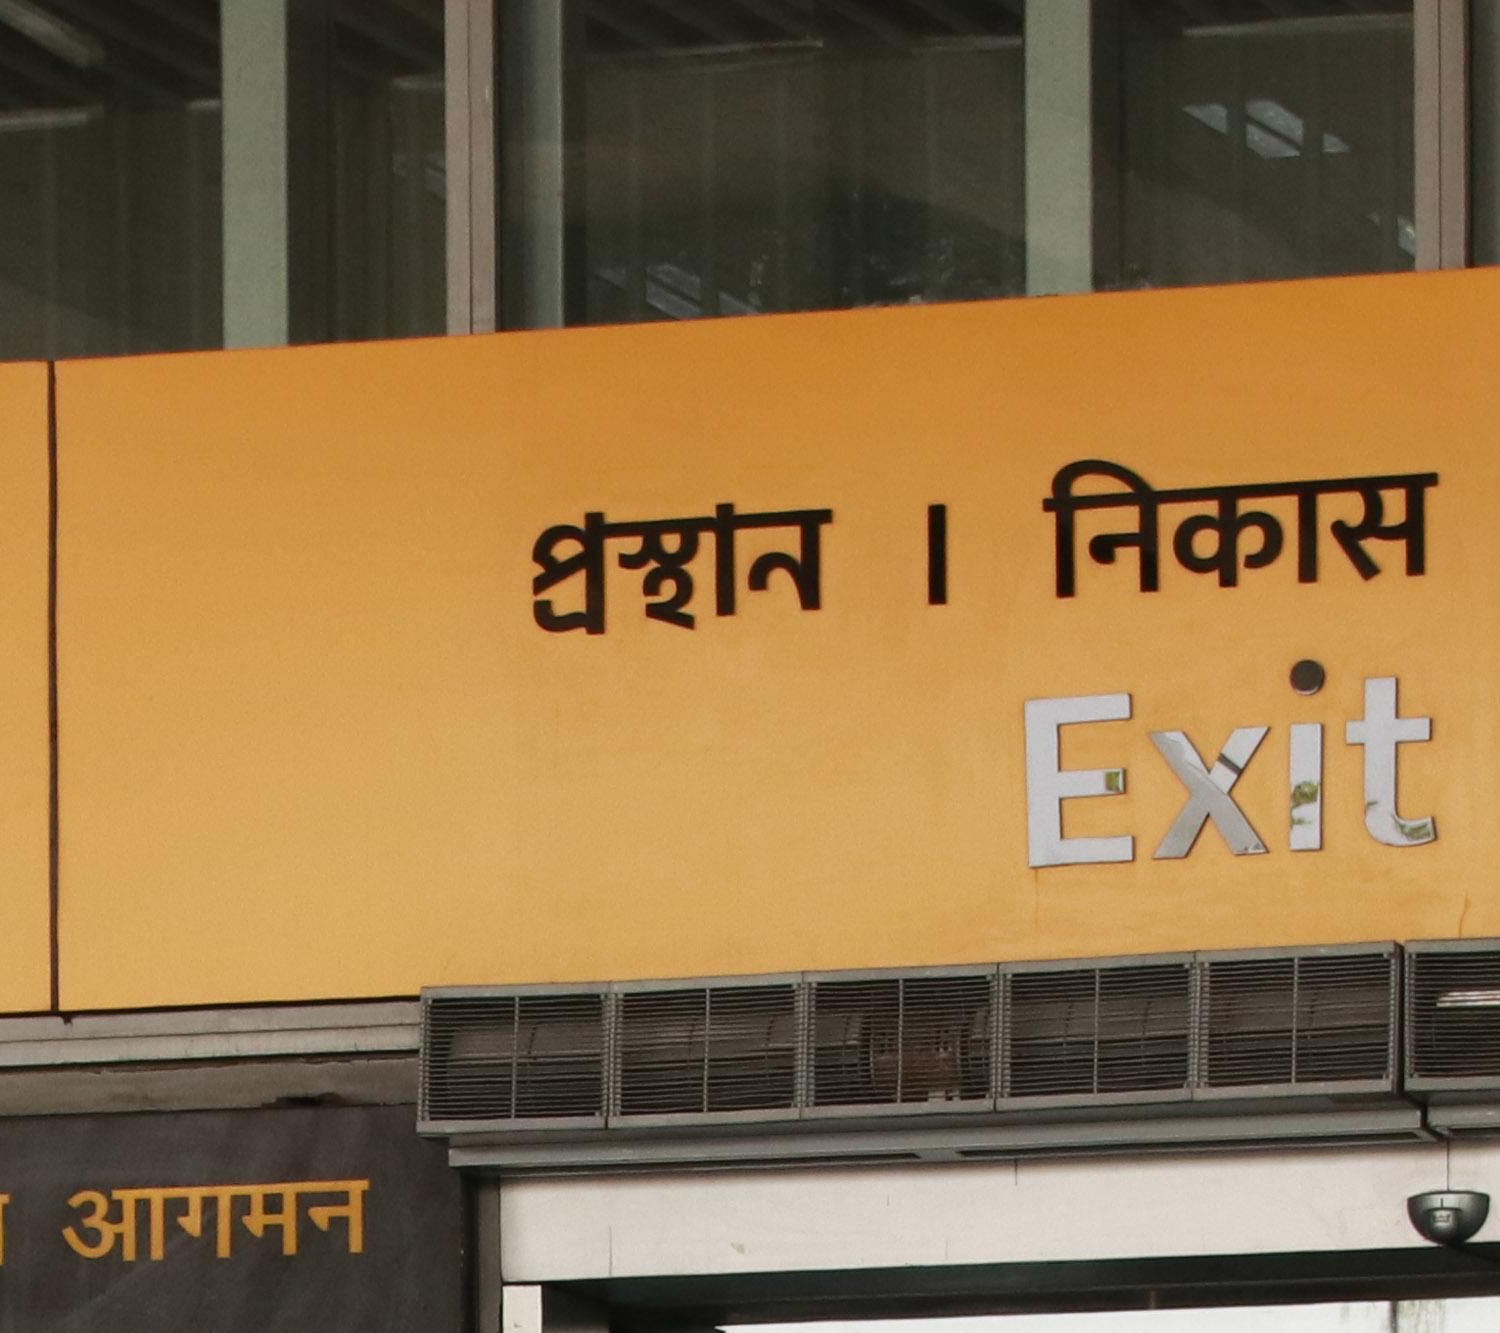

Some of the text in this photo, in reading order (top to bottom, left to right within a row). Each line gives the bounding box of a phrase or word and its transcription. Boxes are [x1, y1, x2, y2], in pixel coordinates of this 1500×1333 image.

[531, 503, 833, 636] প্রস্থান
[1043, 458, 1438, 599] निकास
[1023, 658, 1437, 869] Exit
[61, 1179, 370, 1263] आगमन
